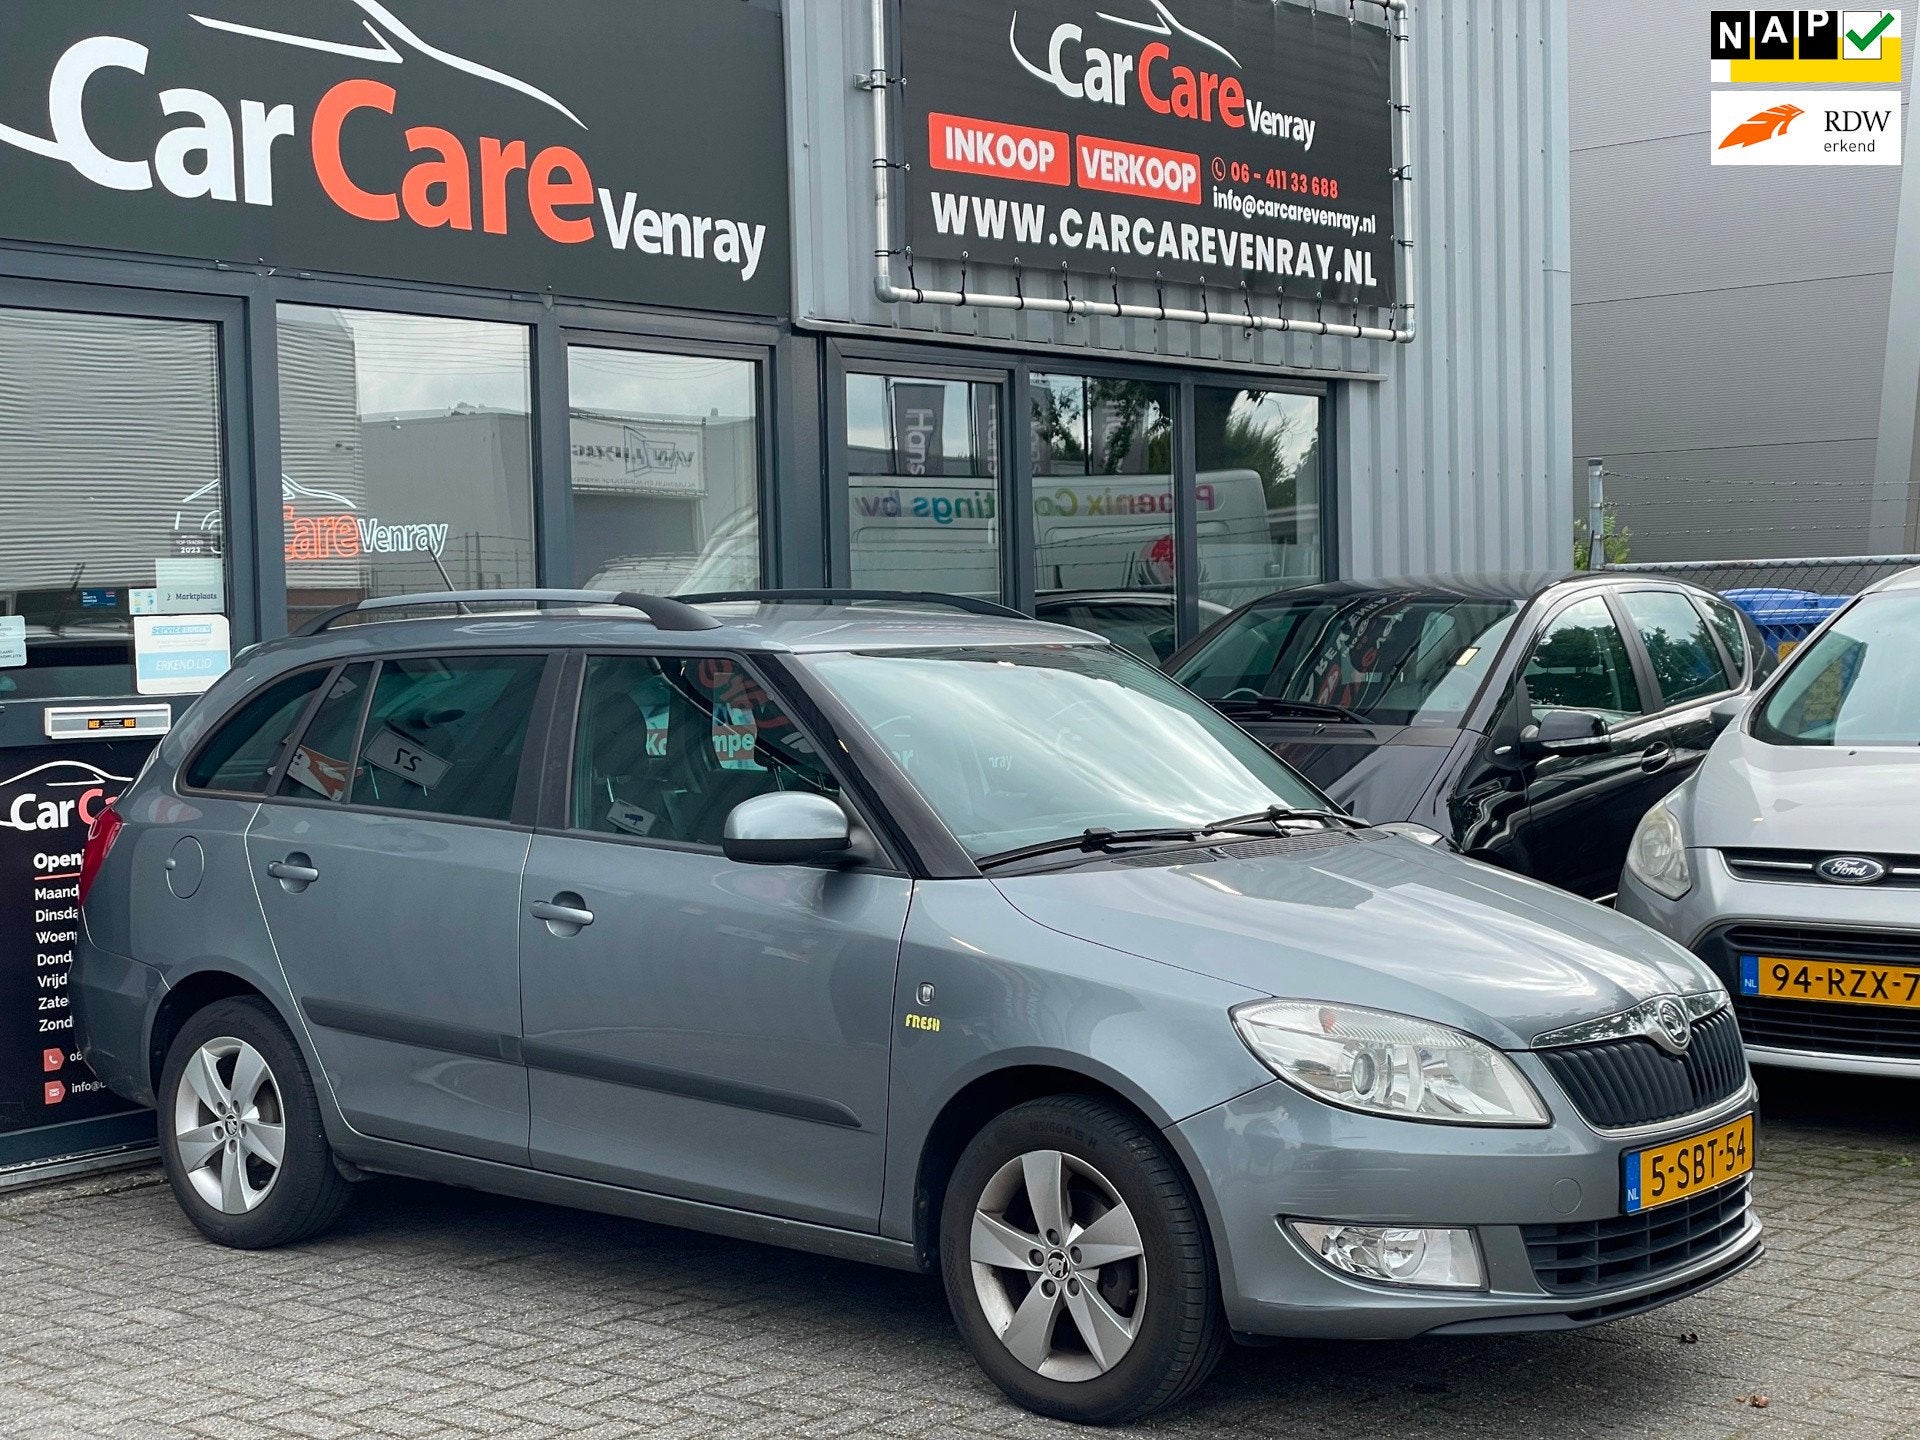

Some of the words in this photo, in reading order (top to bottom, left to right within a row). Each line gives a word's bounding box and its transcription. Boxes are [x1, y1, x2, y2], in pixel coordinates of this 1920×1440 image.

[1246, 98, 1316, 151] Venray
[945, 126, 1055, 172] INKOOP
[1081, 146, 1197, 193] VERKOOP
[1230, 161, 1250, 183] 06
[1265, 168, 1287, 190] 411
[1290, 171, 1308, 194] 33
[1311, 175, 1339, 199] 688
[1213, 185, 1376, 237] info@carcarevenray.nl
[598, 187, 766, 282] Venray
[930, 191, 1377, 287] WWW.CARCAREVENRAY.NL
[358, 518, 448, 559] Venray
[175, 592, 217, 602] Marktplaats
[156, 659, 195, 671] ERKEND
[196, 658, 212, 669] LID
[1831, 858, 1868, 878] Ford
[1744, 978, 1757, 988] NL
[1772, 963, 1920, 1001] 94-RZX-7
[905, 1013, 940, 1032] FRESH
[1651, 1126, 1746, 1197] 5-SBT-54
[1627, 1187, 1639, 1202] NL
